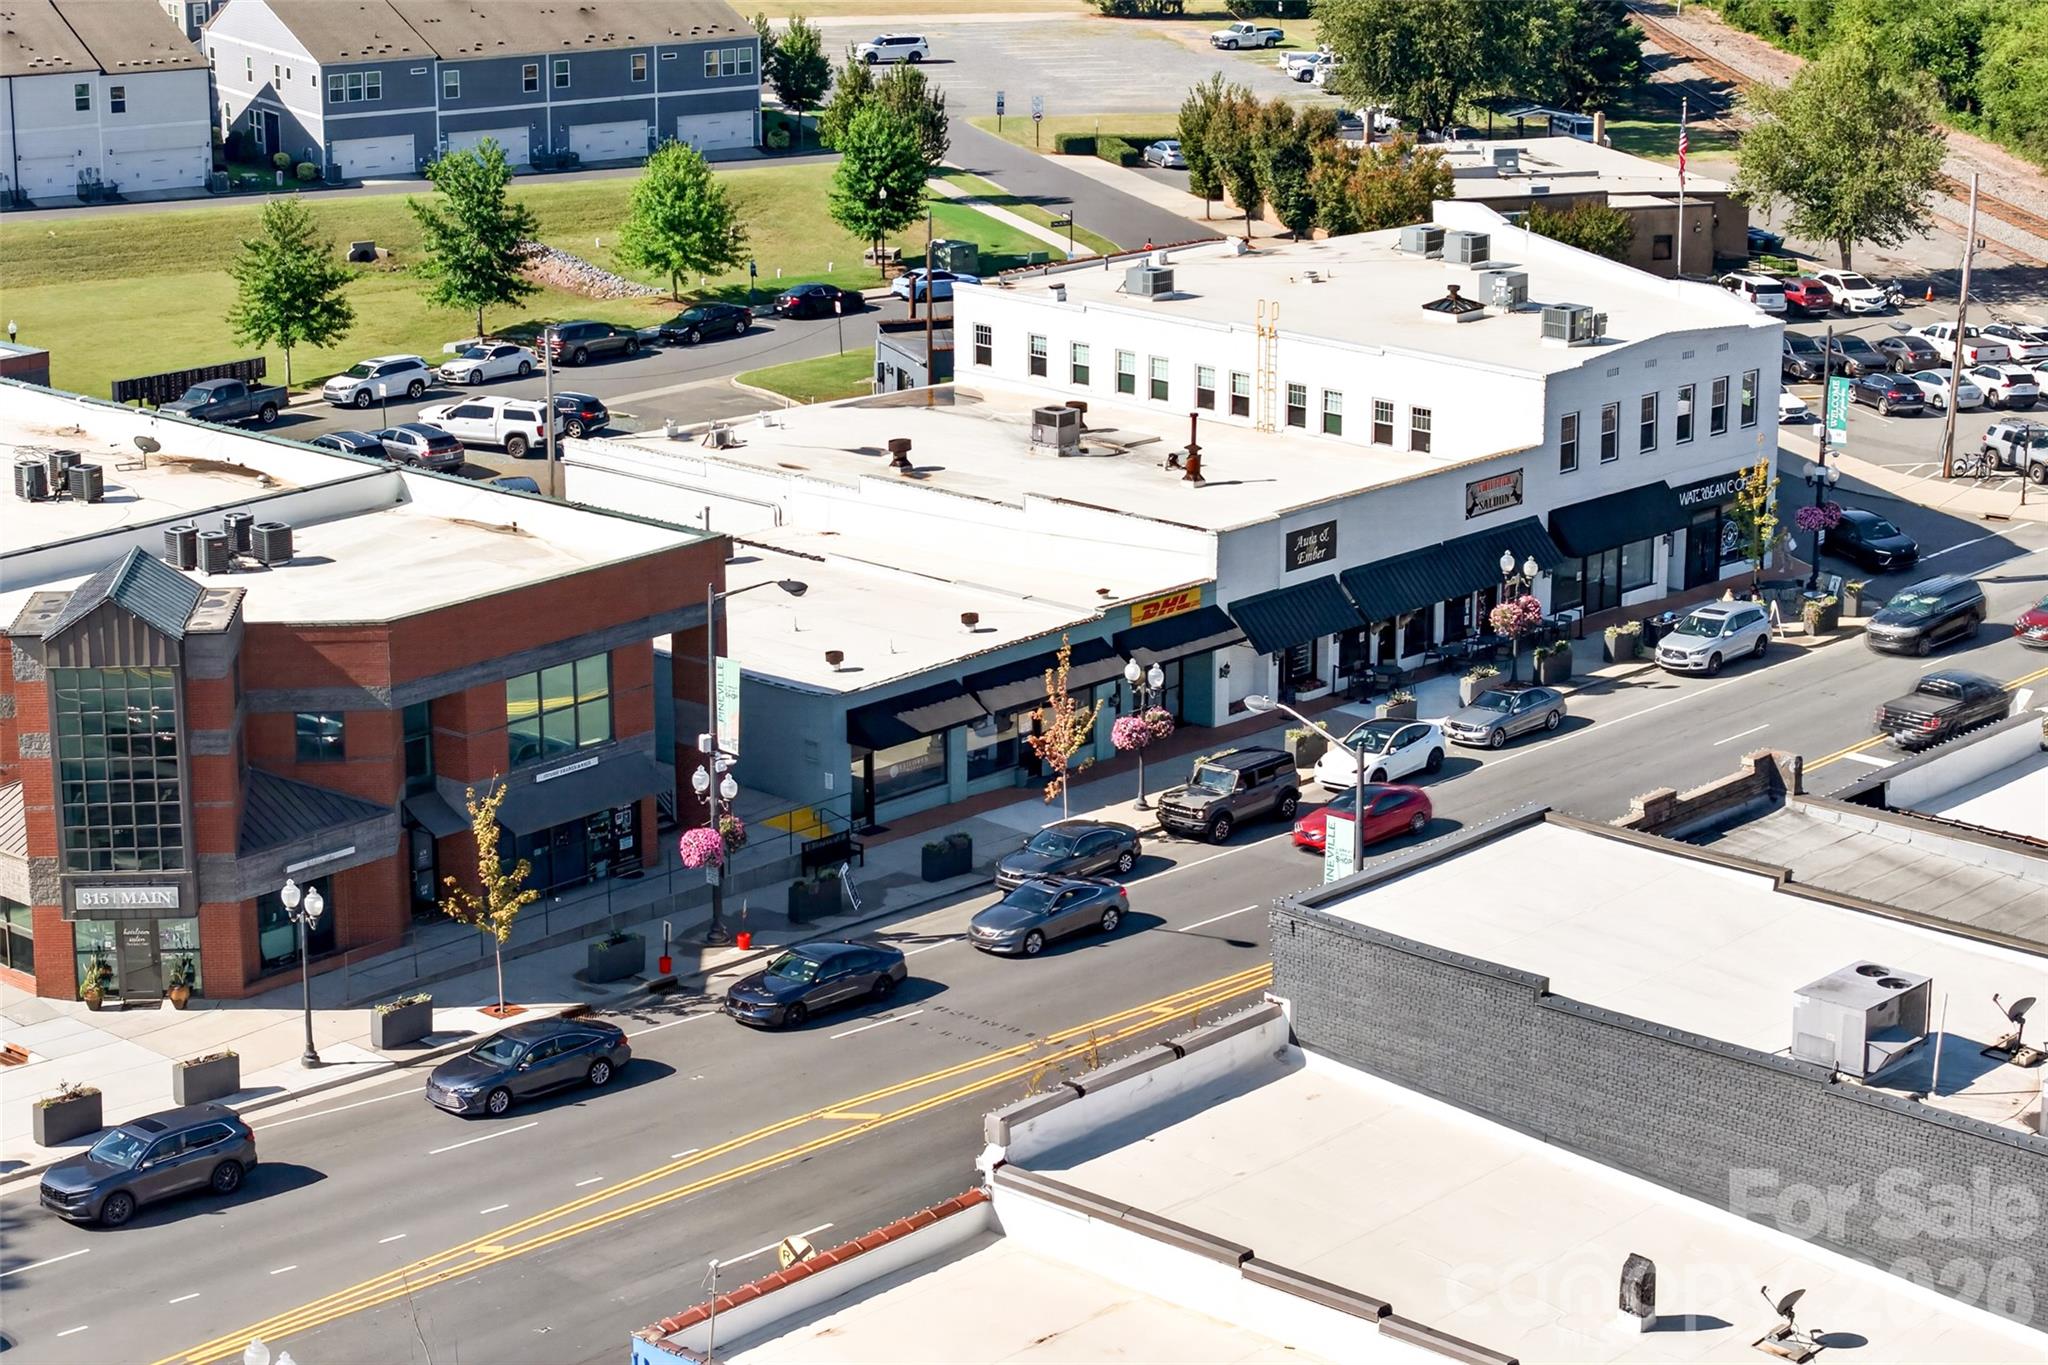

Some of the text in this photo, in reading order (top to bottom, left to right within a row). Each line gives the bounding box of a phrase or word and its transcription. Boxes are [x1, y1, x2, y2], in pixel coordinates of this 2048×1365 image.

[1831, 380, 1840, 427] WELCOME
[1479, 493, 1510, 511] SALOON
[1297, 545, 1327, 565] Ember
[1140, 593, 1188, 621] DHL
[717, 661, 725, 723] PINEVILLE
[1326, 822, 1336, 882] INEVILLE
[82, 891, 171, 905] 315 MAIN
